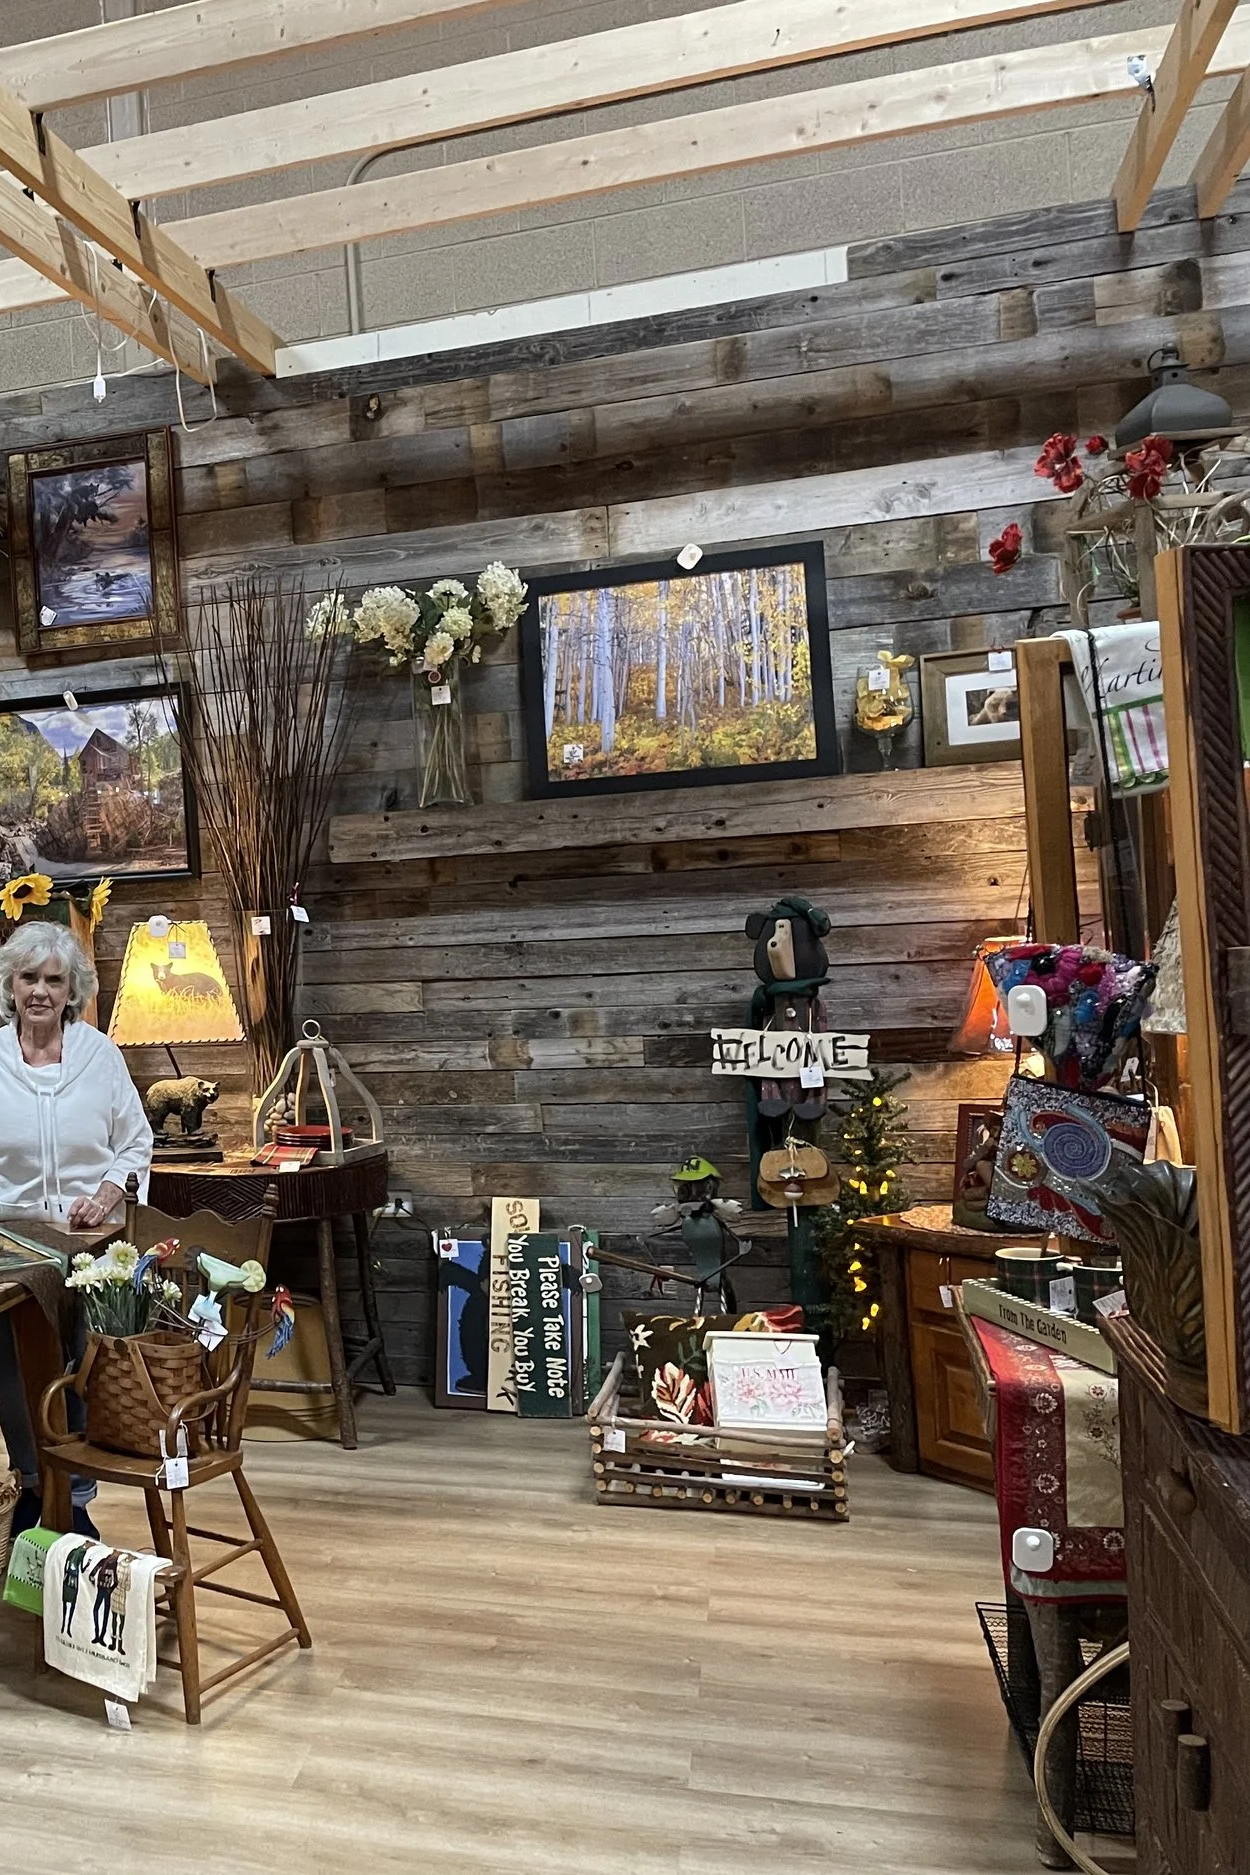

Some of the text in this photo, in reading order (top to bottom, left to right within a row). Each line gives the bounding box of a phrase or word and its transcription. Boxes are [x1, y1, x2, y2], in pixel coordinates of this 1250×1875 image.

[713, 1032, 849, 1072] WELCOME
[491, 1254, 511, 1354] FISHING
[507, 1234, 537, 1392] You Break, You Buy
[537, 1254, 569, 1399] Please Take Note
[1019, 1312, 1035, 1332] The
[1036, 1318, 1067, 1345] Garden
